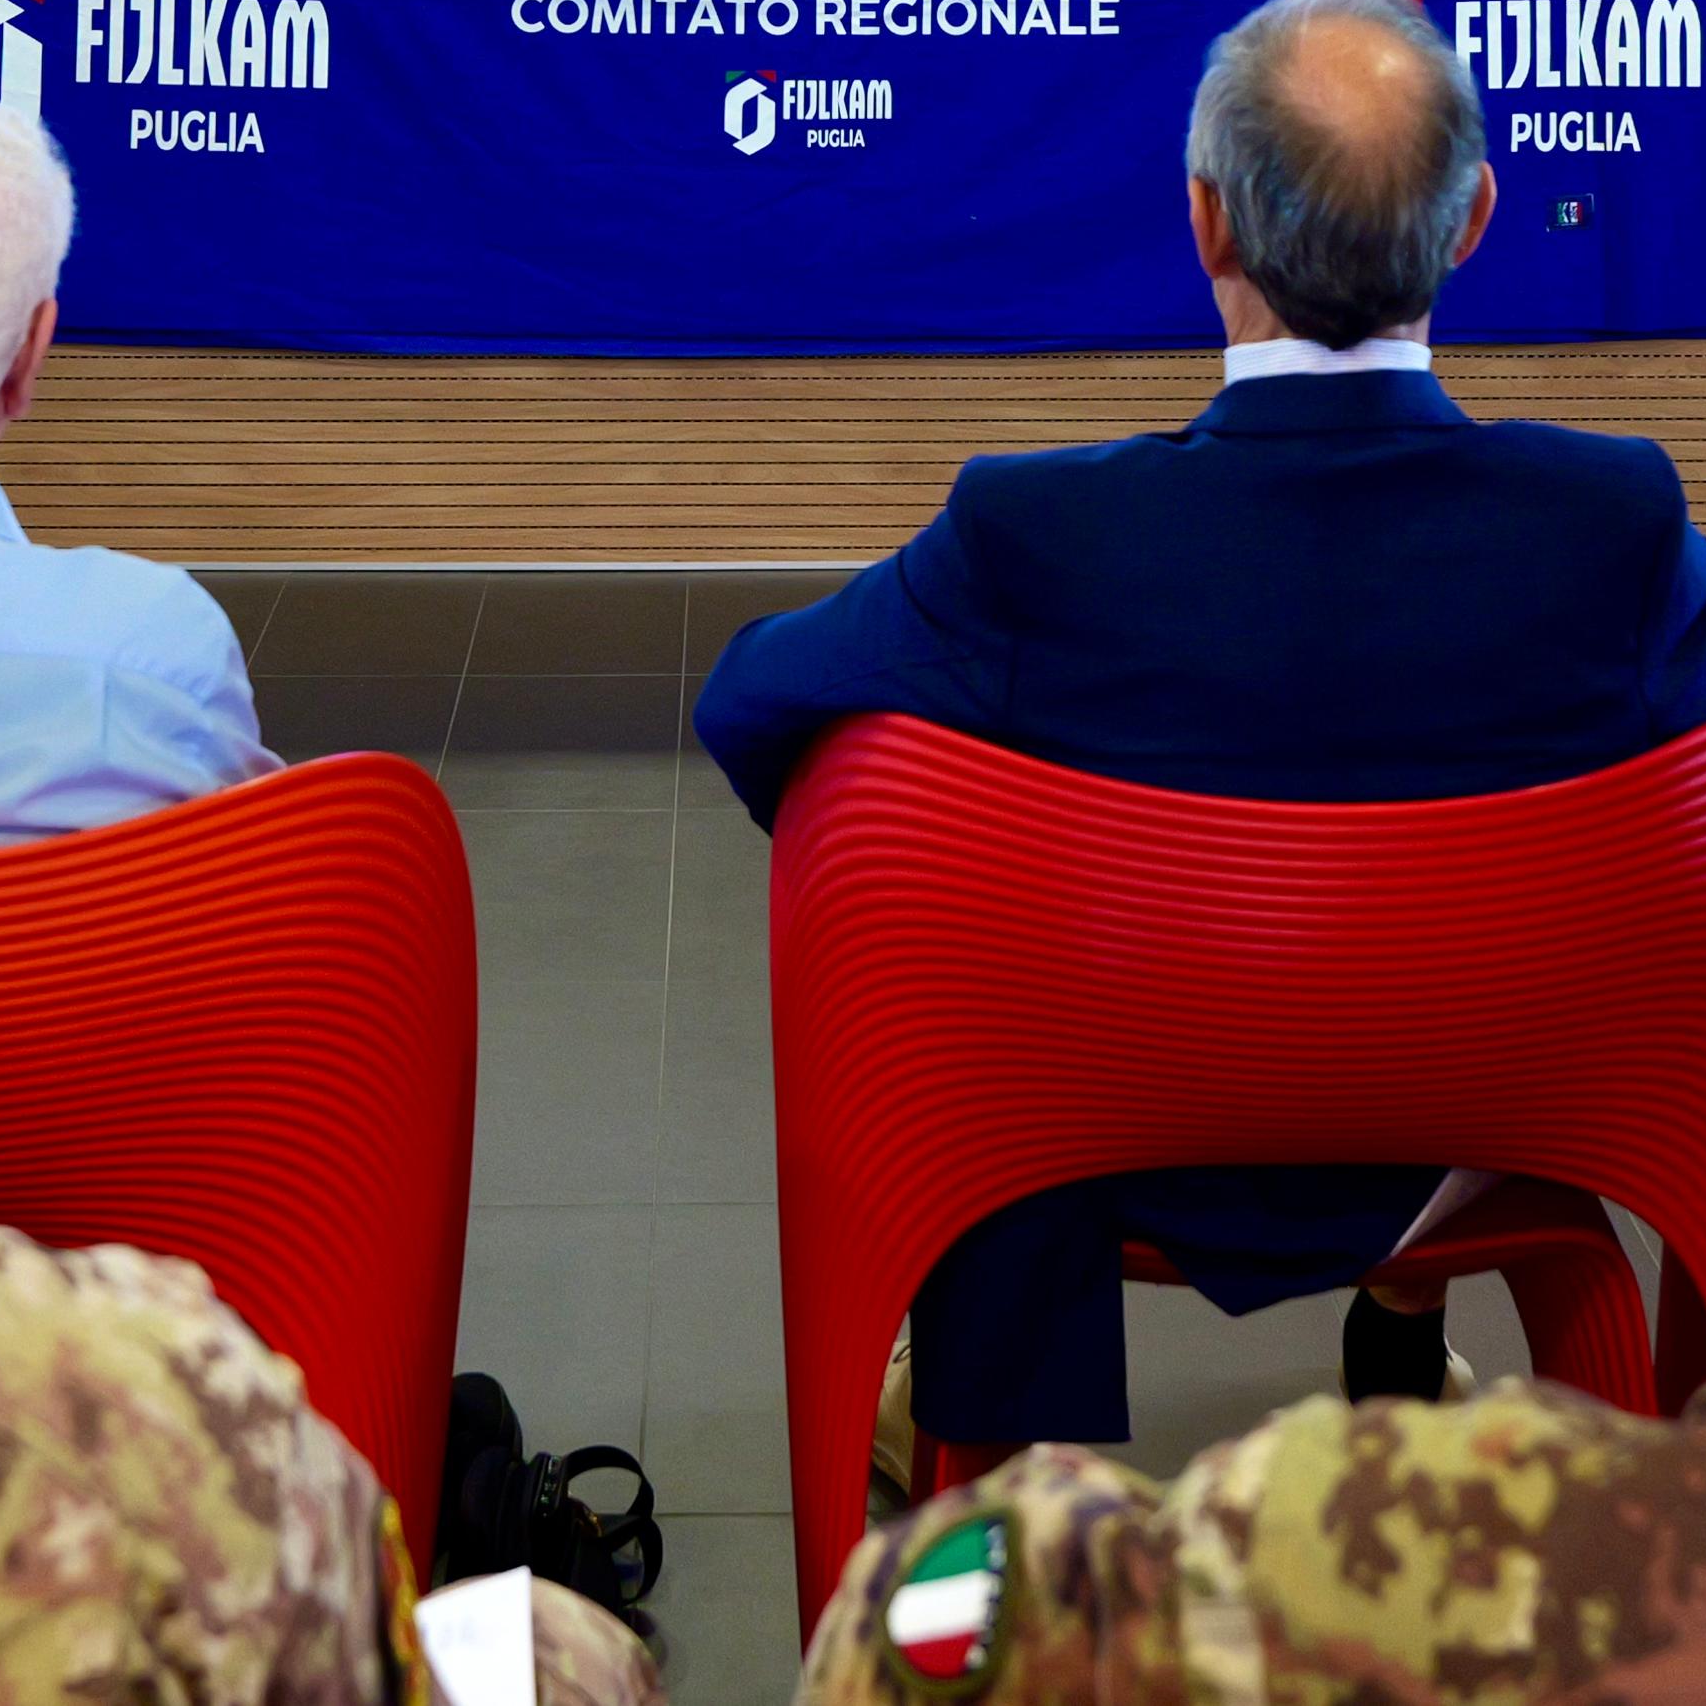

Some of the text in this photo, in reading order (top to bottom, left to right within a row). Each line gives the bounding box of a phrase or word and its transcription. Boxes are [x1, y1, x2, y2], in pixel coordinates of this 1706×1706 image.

[782, 79, 893, 121] FIJLKAM
[130, 109, 265, 153] PUGLIA
[806, 128, 866, 149] PUGLIA
[1511, 111, 1641, 152] PUGLIA
